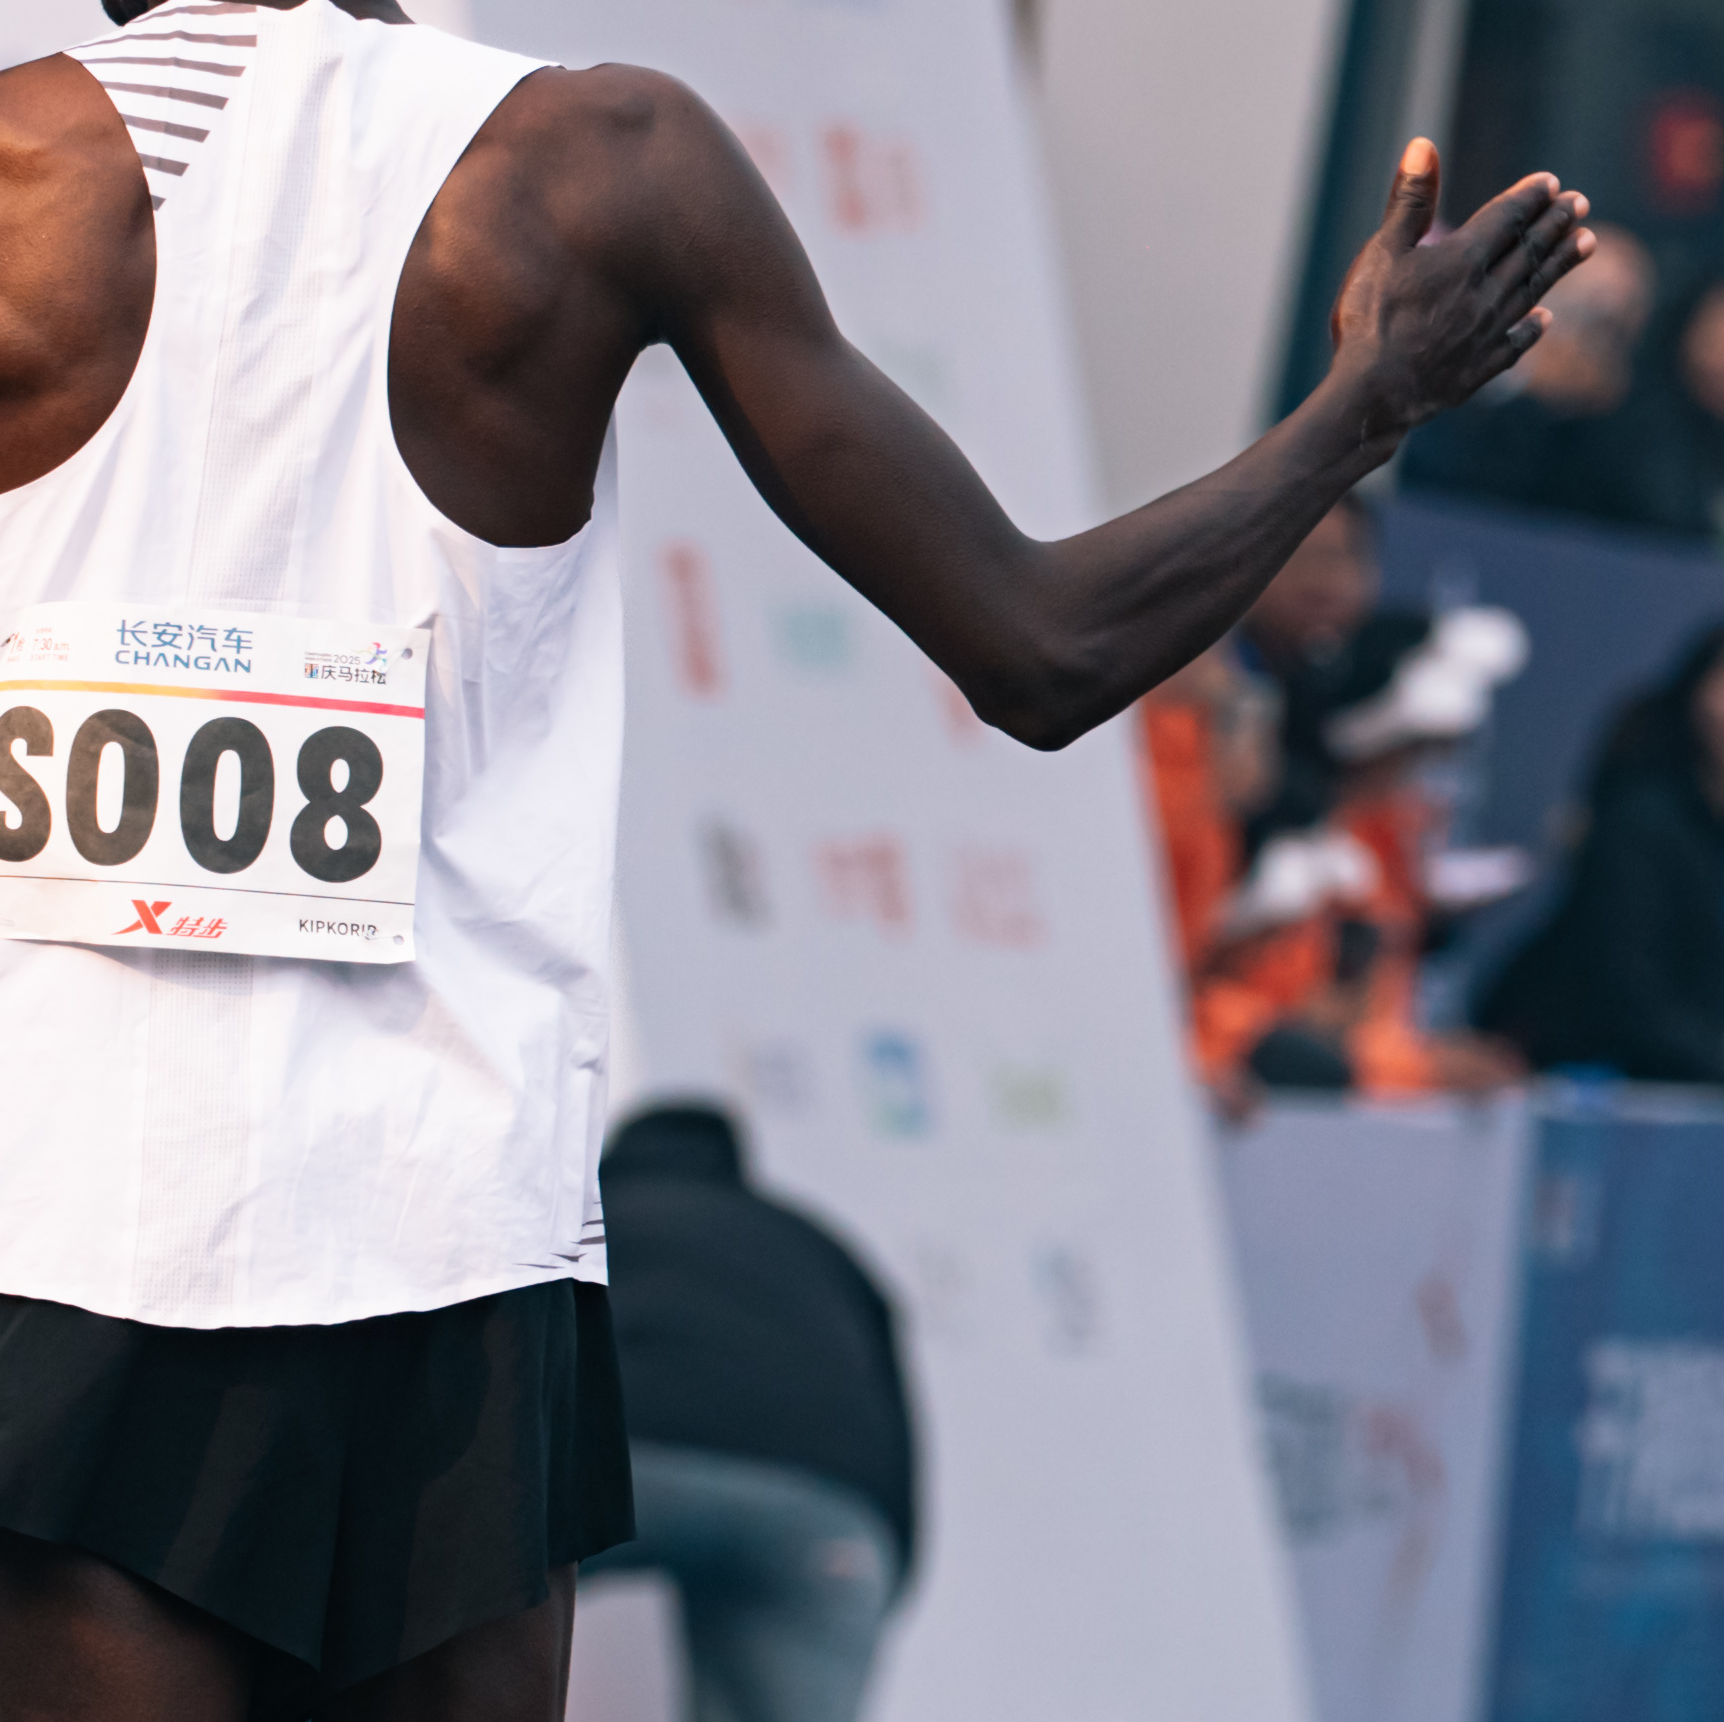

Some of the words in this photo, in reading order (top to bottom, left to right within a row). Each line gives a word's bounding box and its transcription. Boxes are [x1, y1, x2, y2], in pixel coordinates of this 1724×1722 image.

[116, 619, 253, 654] 长安汽车
[115, 650, 251, 673] CHANGAN
[334, 654, 361, 666] 2025
[304, 662, 387, 685] 重庆马拉松
[166, 916, 228, 939] 特步
